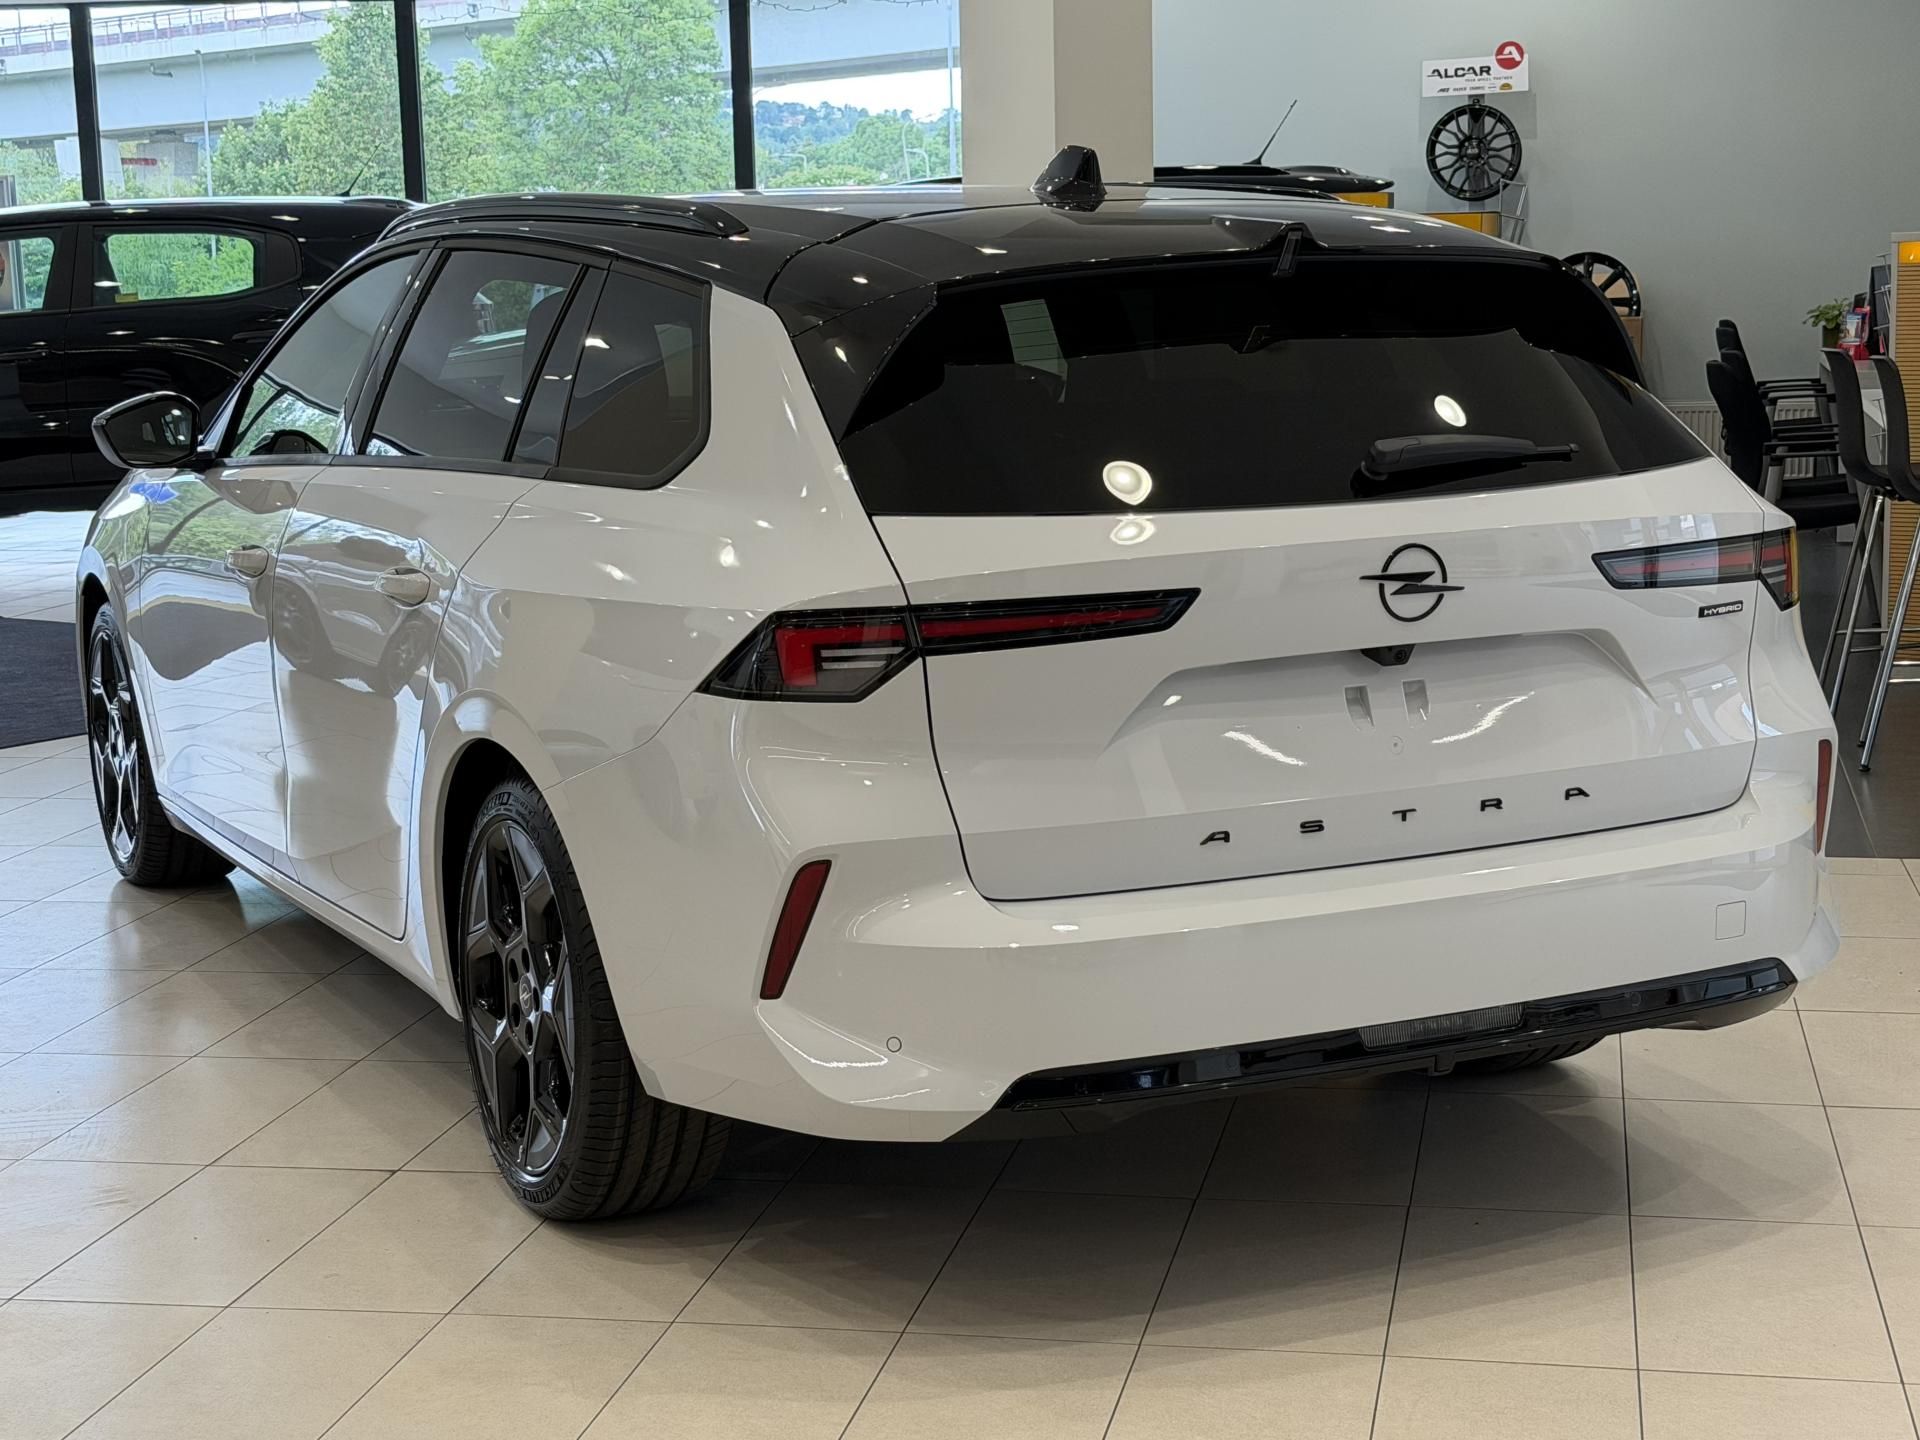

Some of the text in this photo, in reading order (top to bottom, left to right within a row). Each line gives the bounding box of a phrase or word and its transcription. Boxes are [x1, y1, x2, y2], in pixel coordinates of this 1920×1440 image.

[1427, 65, 1491, 79] ALCAR
[1704, 604, 1742, 616] HYBRID
[1200, 787, 1590, 845] ASTRA
